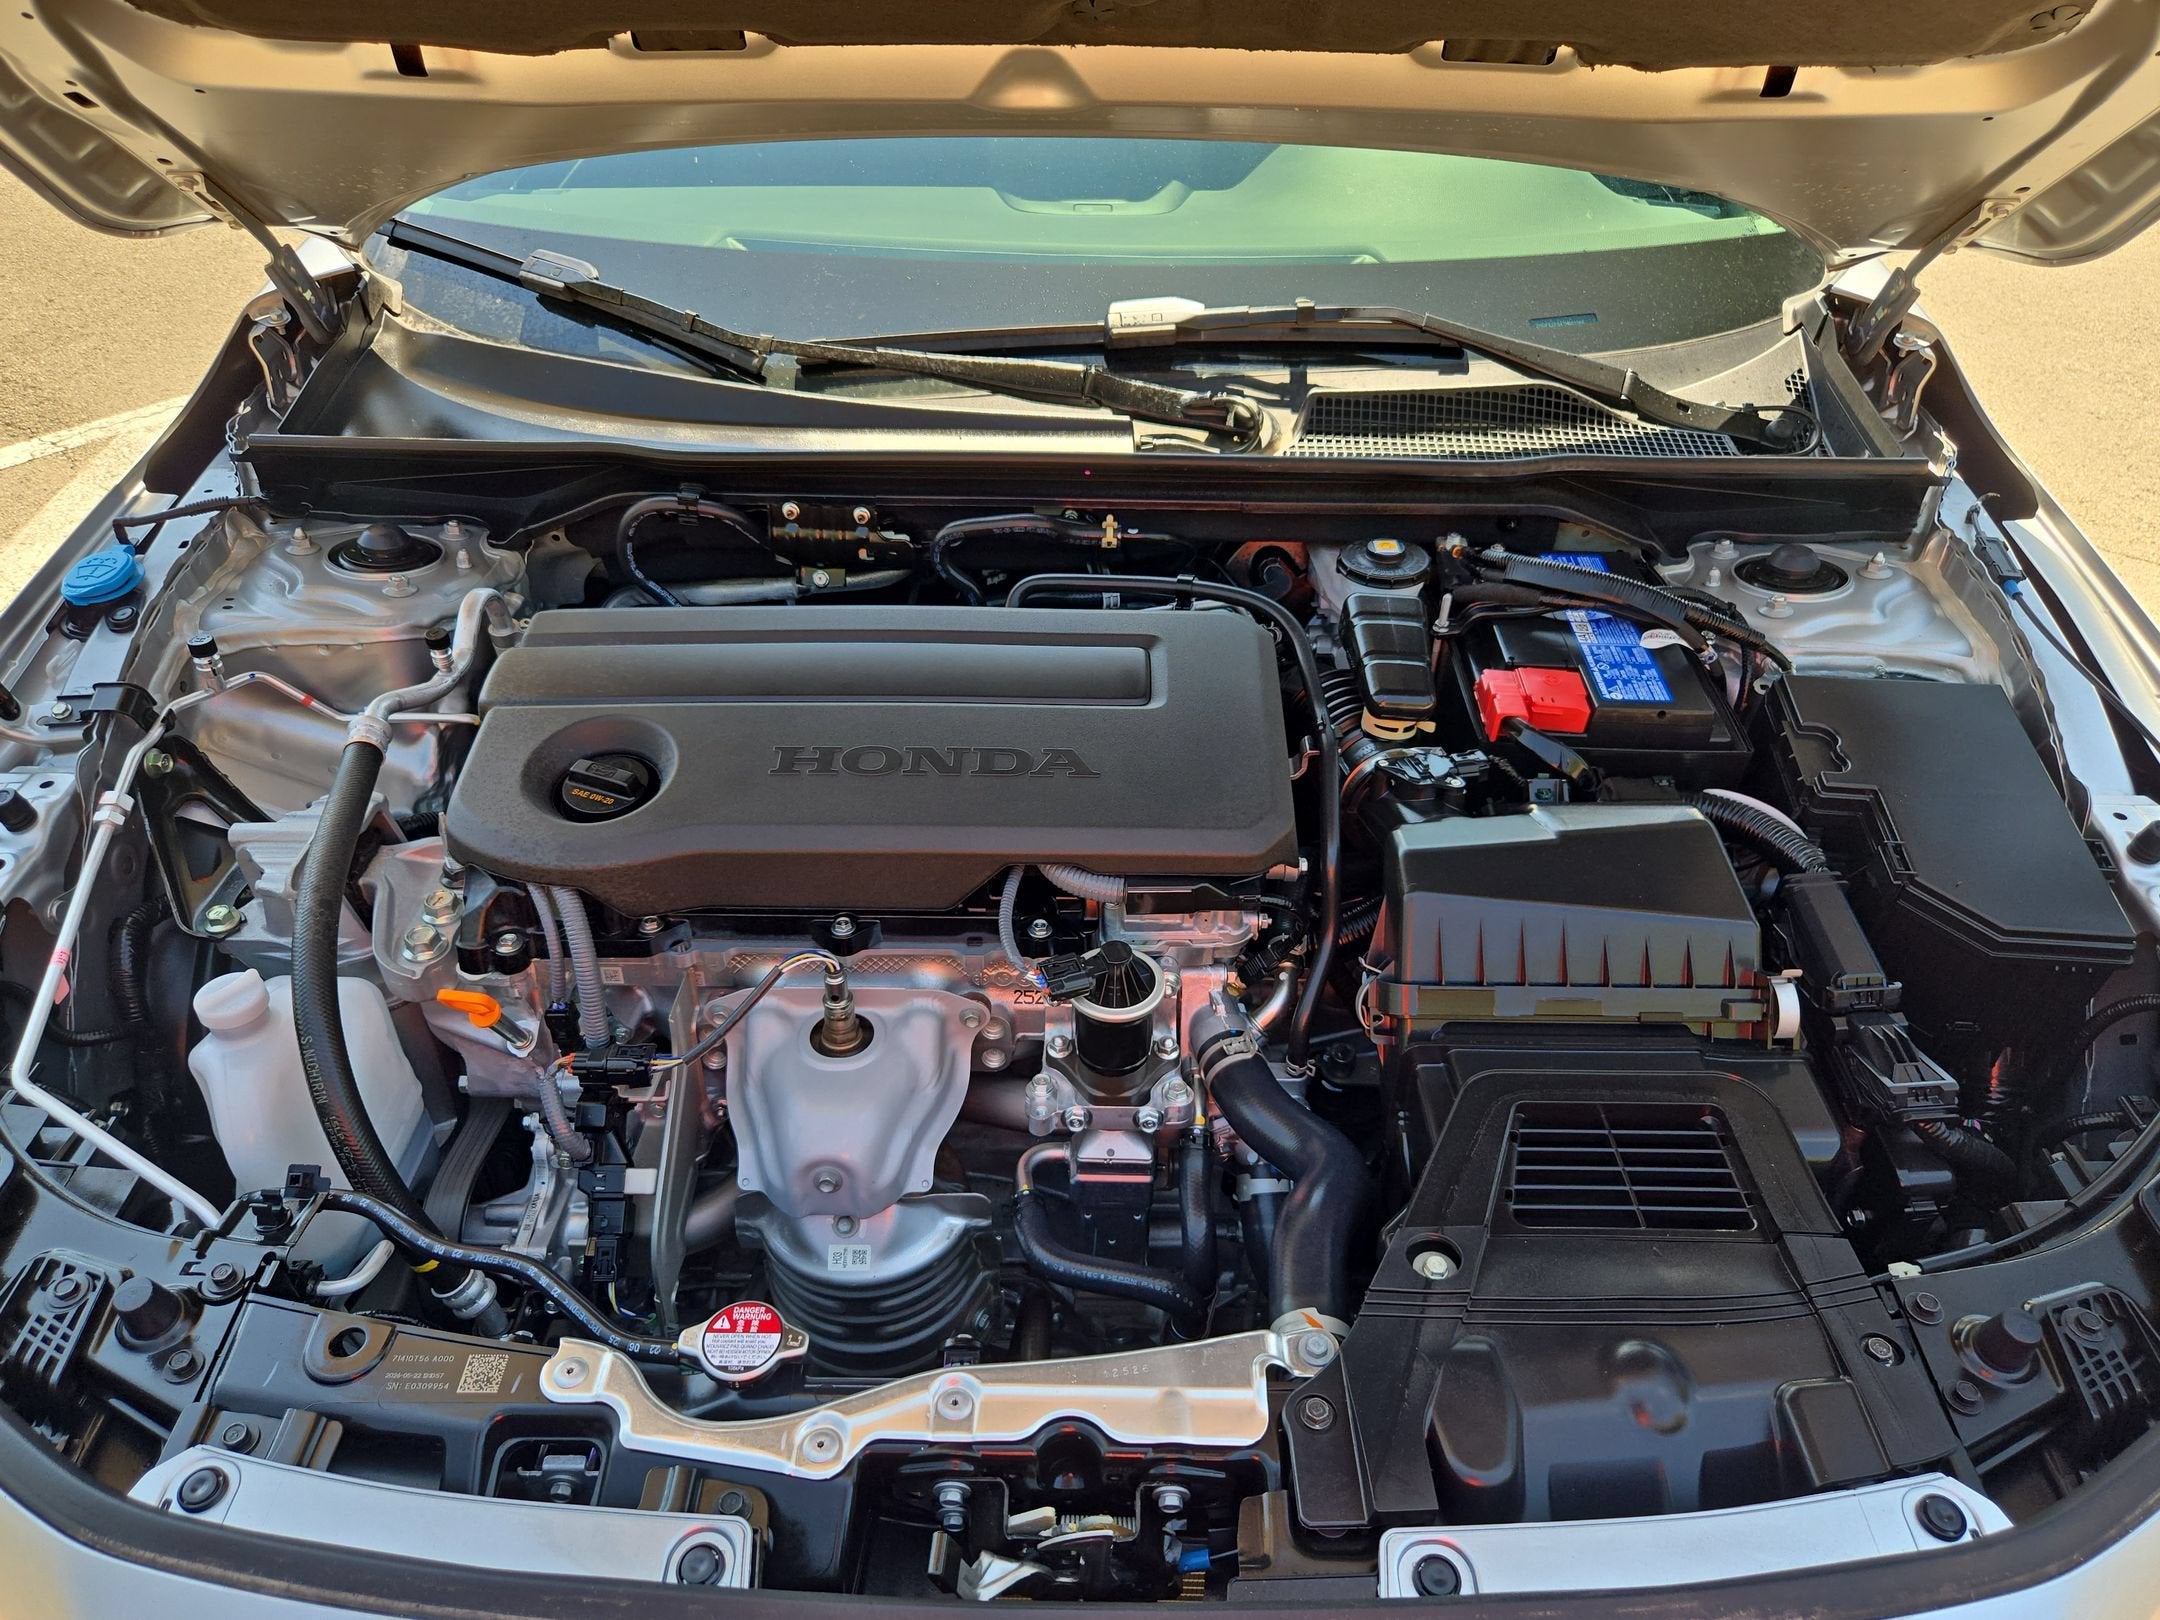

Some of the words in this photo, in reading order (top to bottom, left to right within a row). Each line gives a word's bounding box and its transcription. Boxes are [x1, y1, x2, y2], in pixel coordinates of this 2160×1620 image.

[768, 745, 1101, 778] HONDA
[571, 788, 590, 798] SAE
[589, 793, 615, 805] 0W-20
[303, 1049, 329, 1105] NICHIRIN
[733, 1306, 766, 1314] DANGER
[732, 1313, 772, 1321] WARNUNG
[432, 1354, 455, 1362] A000
[404, 1382, 450, 1390] E0309954
